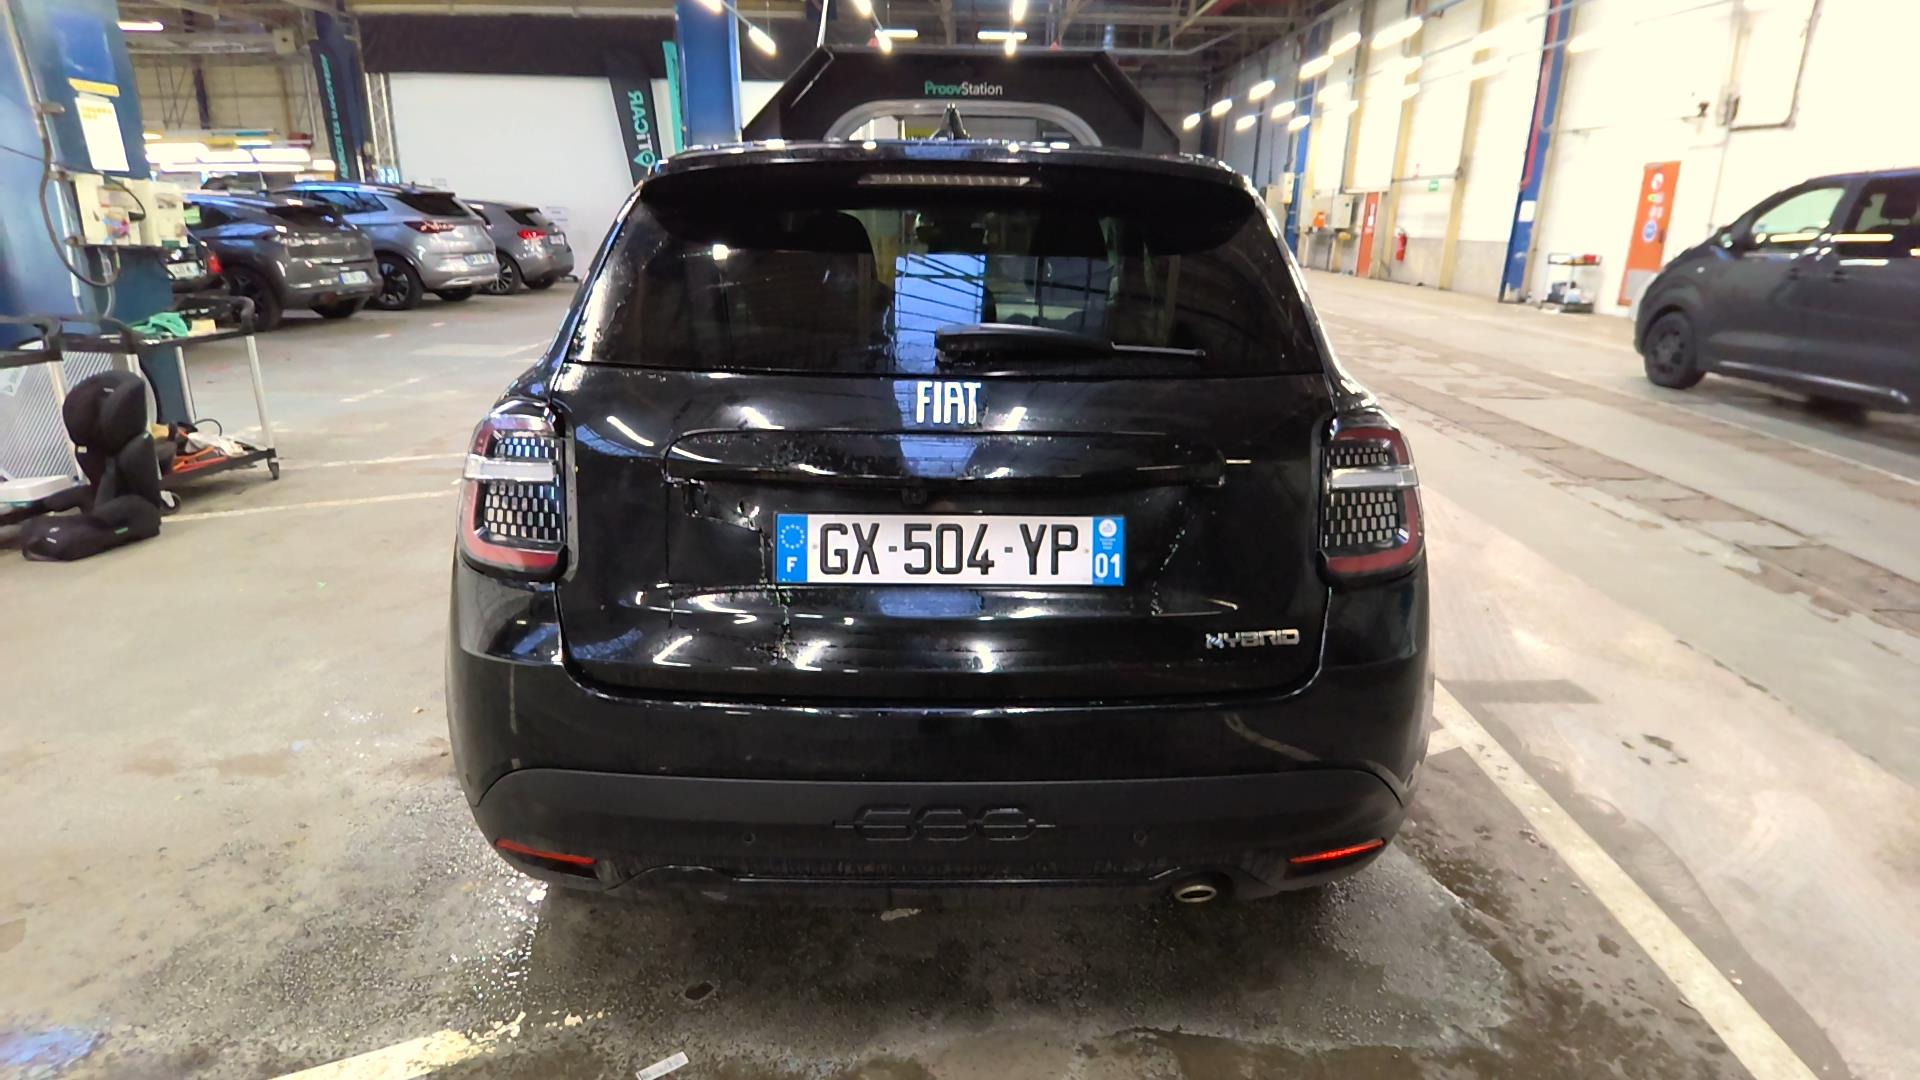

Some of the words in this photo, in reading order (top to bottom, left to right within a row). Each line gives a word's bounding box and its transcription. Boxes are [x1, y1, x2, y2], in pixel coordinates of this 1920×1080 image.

[924, 80, 1003, 96] ProovStation
[916, 381, 982, 425] FIAT
[819, 522, 1080, 576] GX-504-YP
[786, 556, 798, 574] F
[1095, 552, 1121, 579] 01
[1205, 628, 1300, 650] HYBRID
